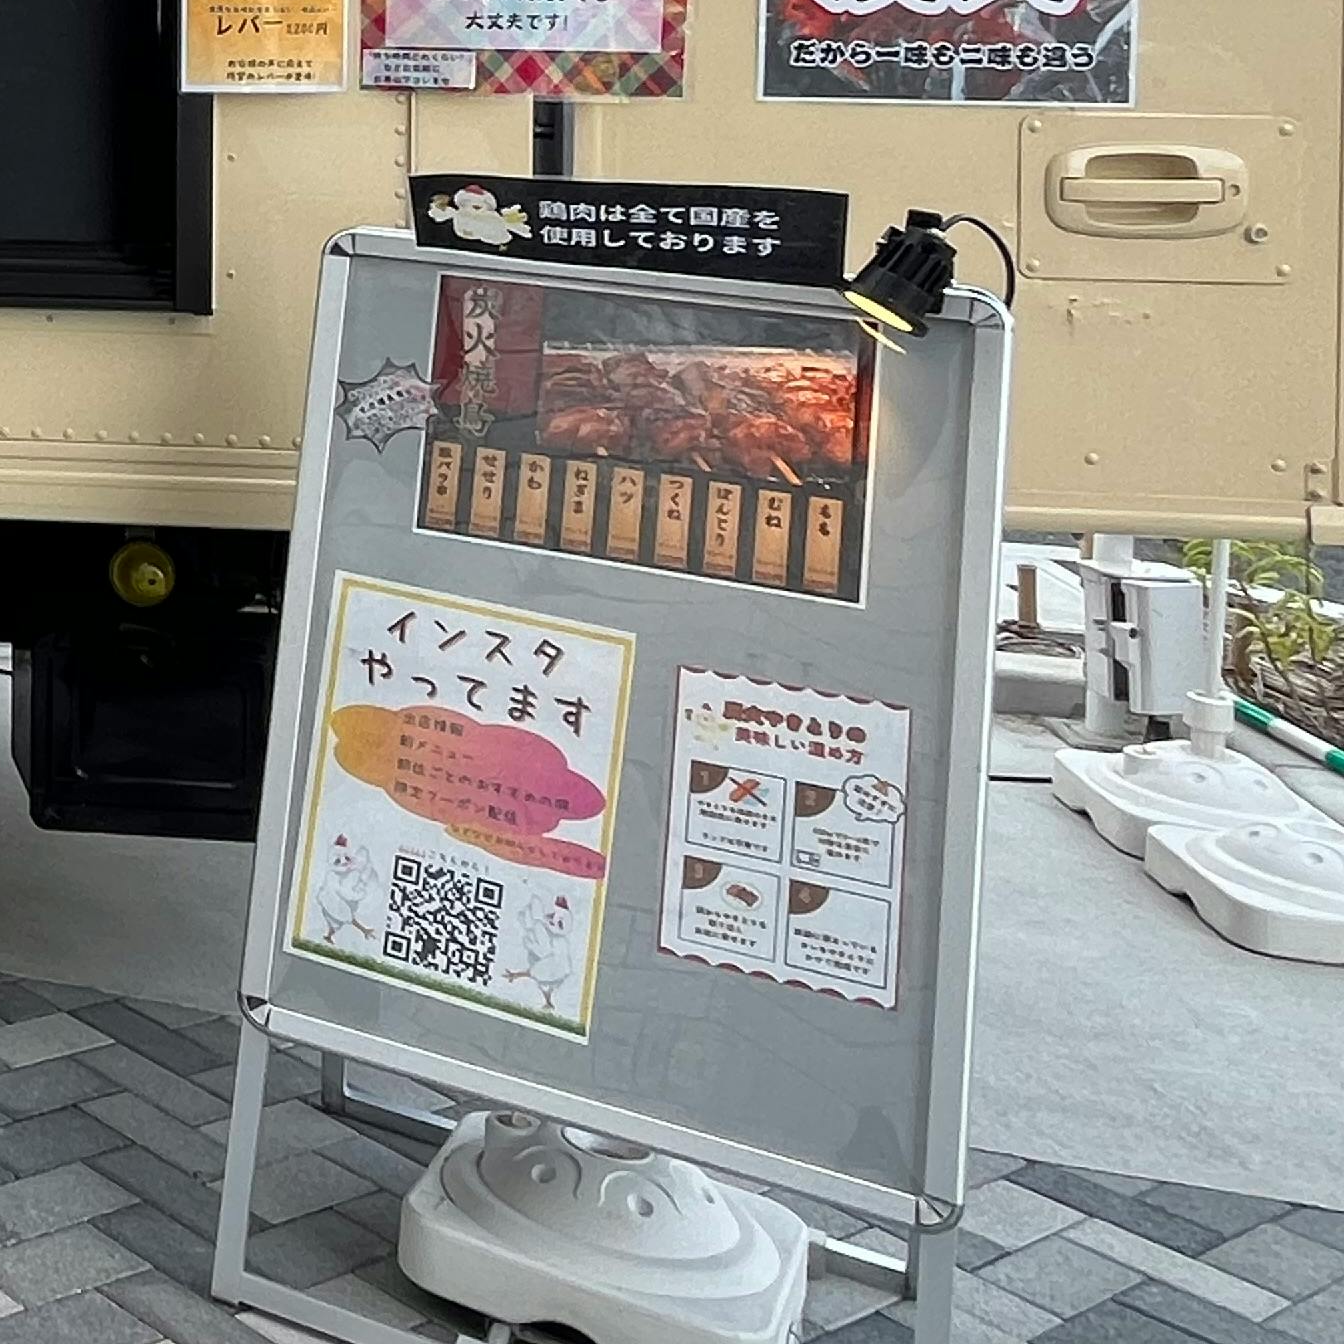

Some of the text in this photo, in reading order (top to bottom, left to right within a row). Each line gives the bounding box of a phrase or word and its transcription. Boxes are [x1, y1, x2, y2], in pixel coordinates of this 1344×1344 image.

[217, 14, 283, 36] レバー
[790, 39, 1095, 70] だから一味も二味も違う
[538, 200, 780, 230] 鶏肉は全て国産を
[539, 224, 782, 256] 使用しております
[453, 285, 503, 437] 炭火焼鳥
[619, 475, 636, 504] ハツ
[387, 611, 565, 676] インスタ
[360, 649, 592, 738] やってます
